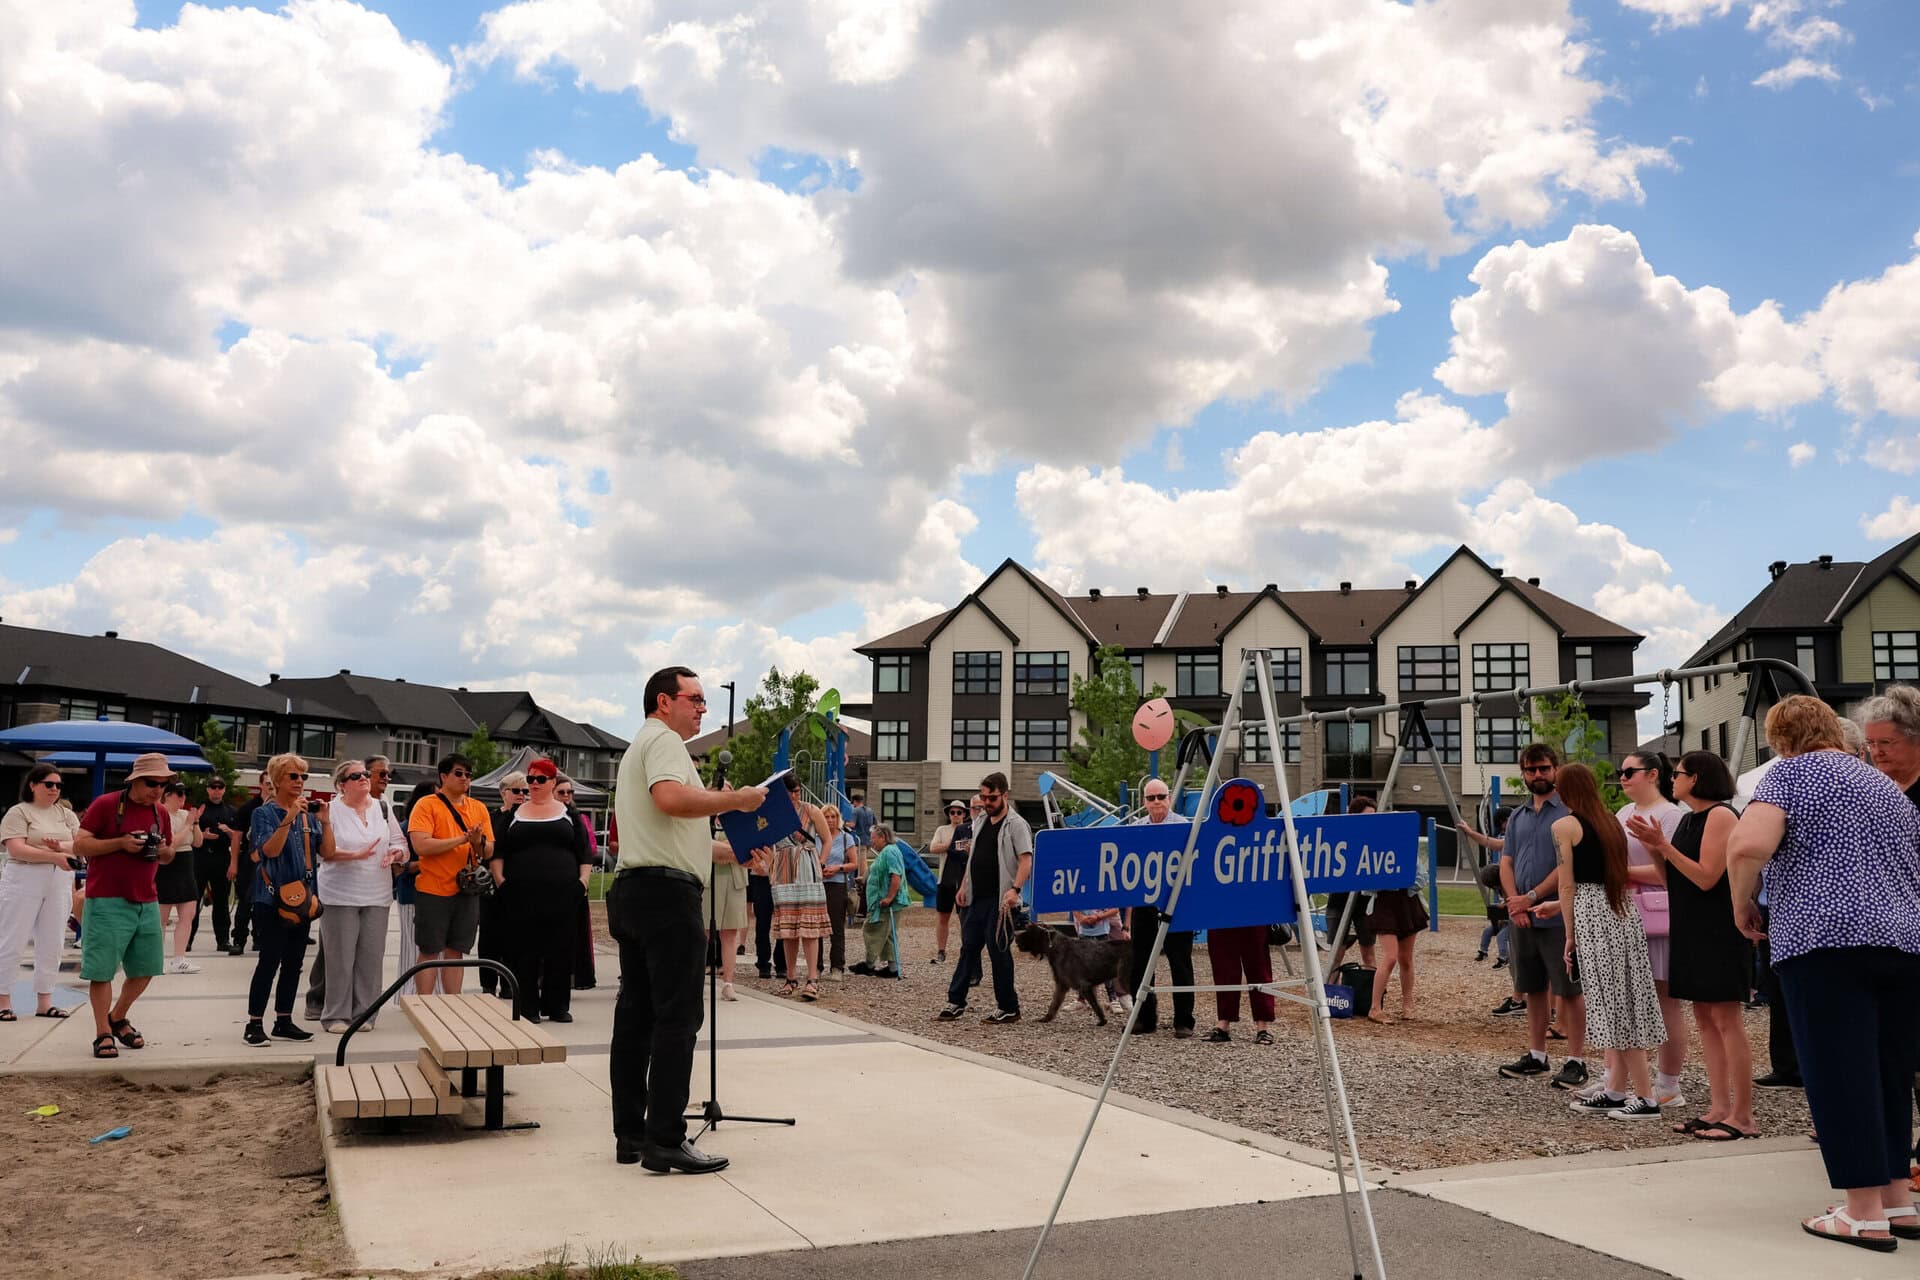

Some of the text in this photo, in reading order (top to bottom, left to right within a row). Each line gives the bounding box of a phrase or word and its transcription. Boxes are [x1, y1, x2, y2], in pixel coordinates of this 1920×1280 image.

[1052, 827, 1400, 904] av. Roger Griffths Ave.
